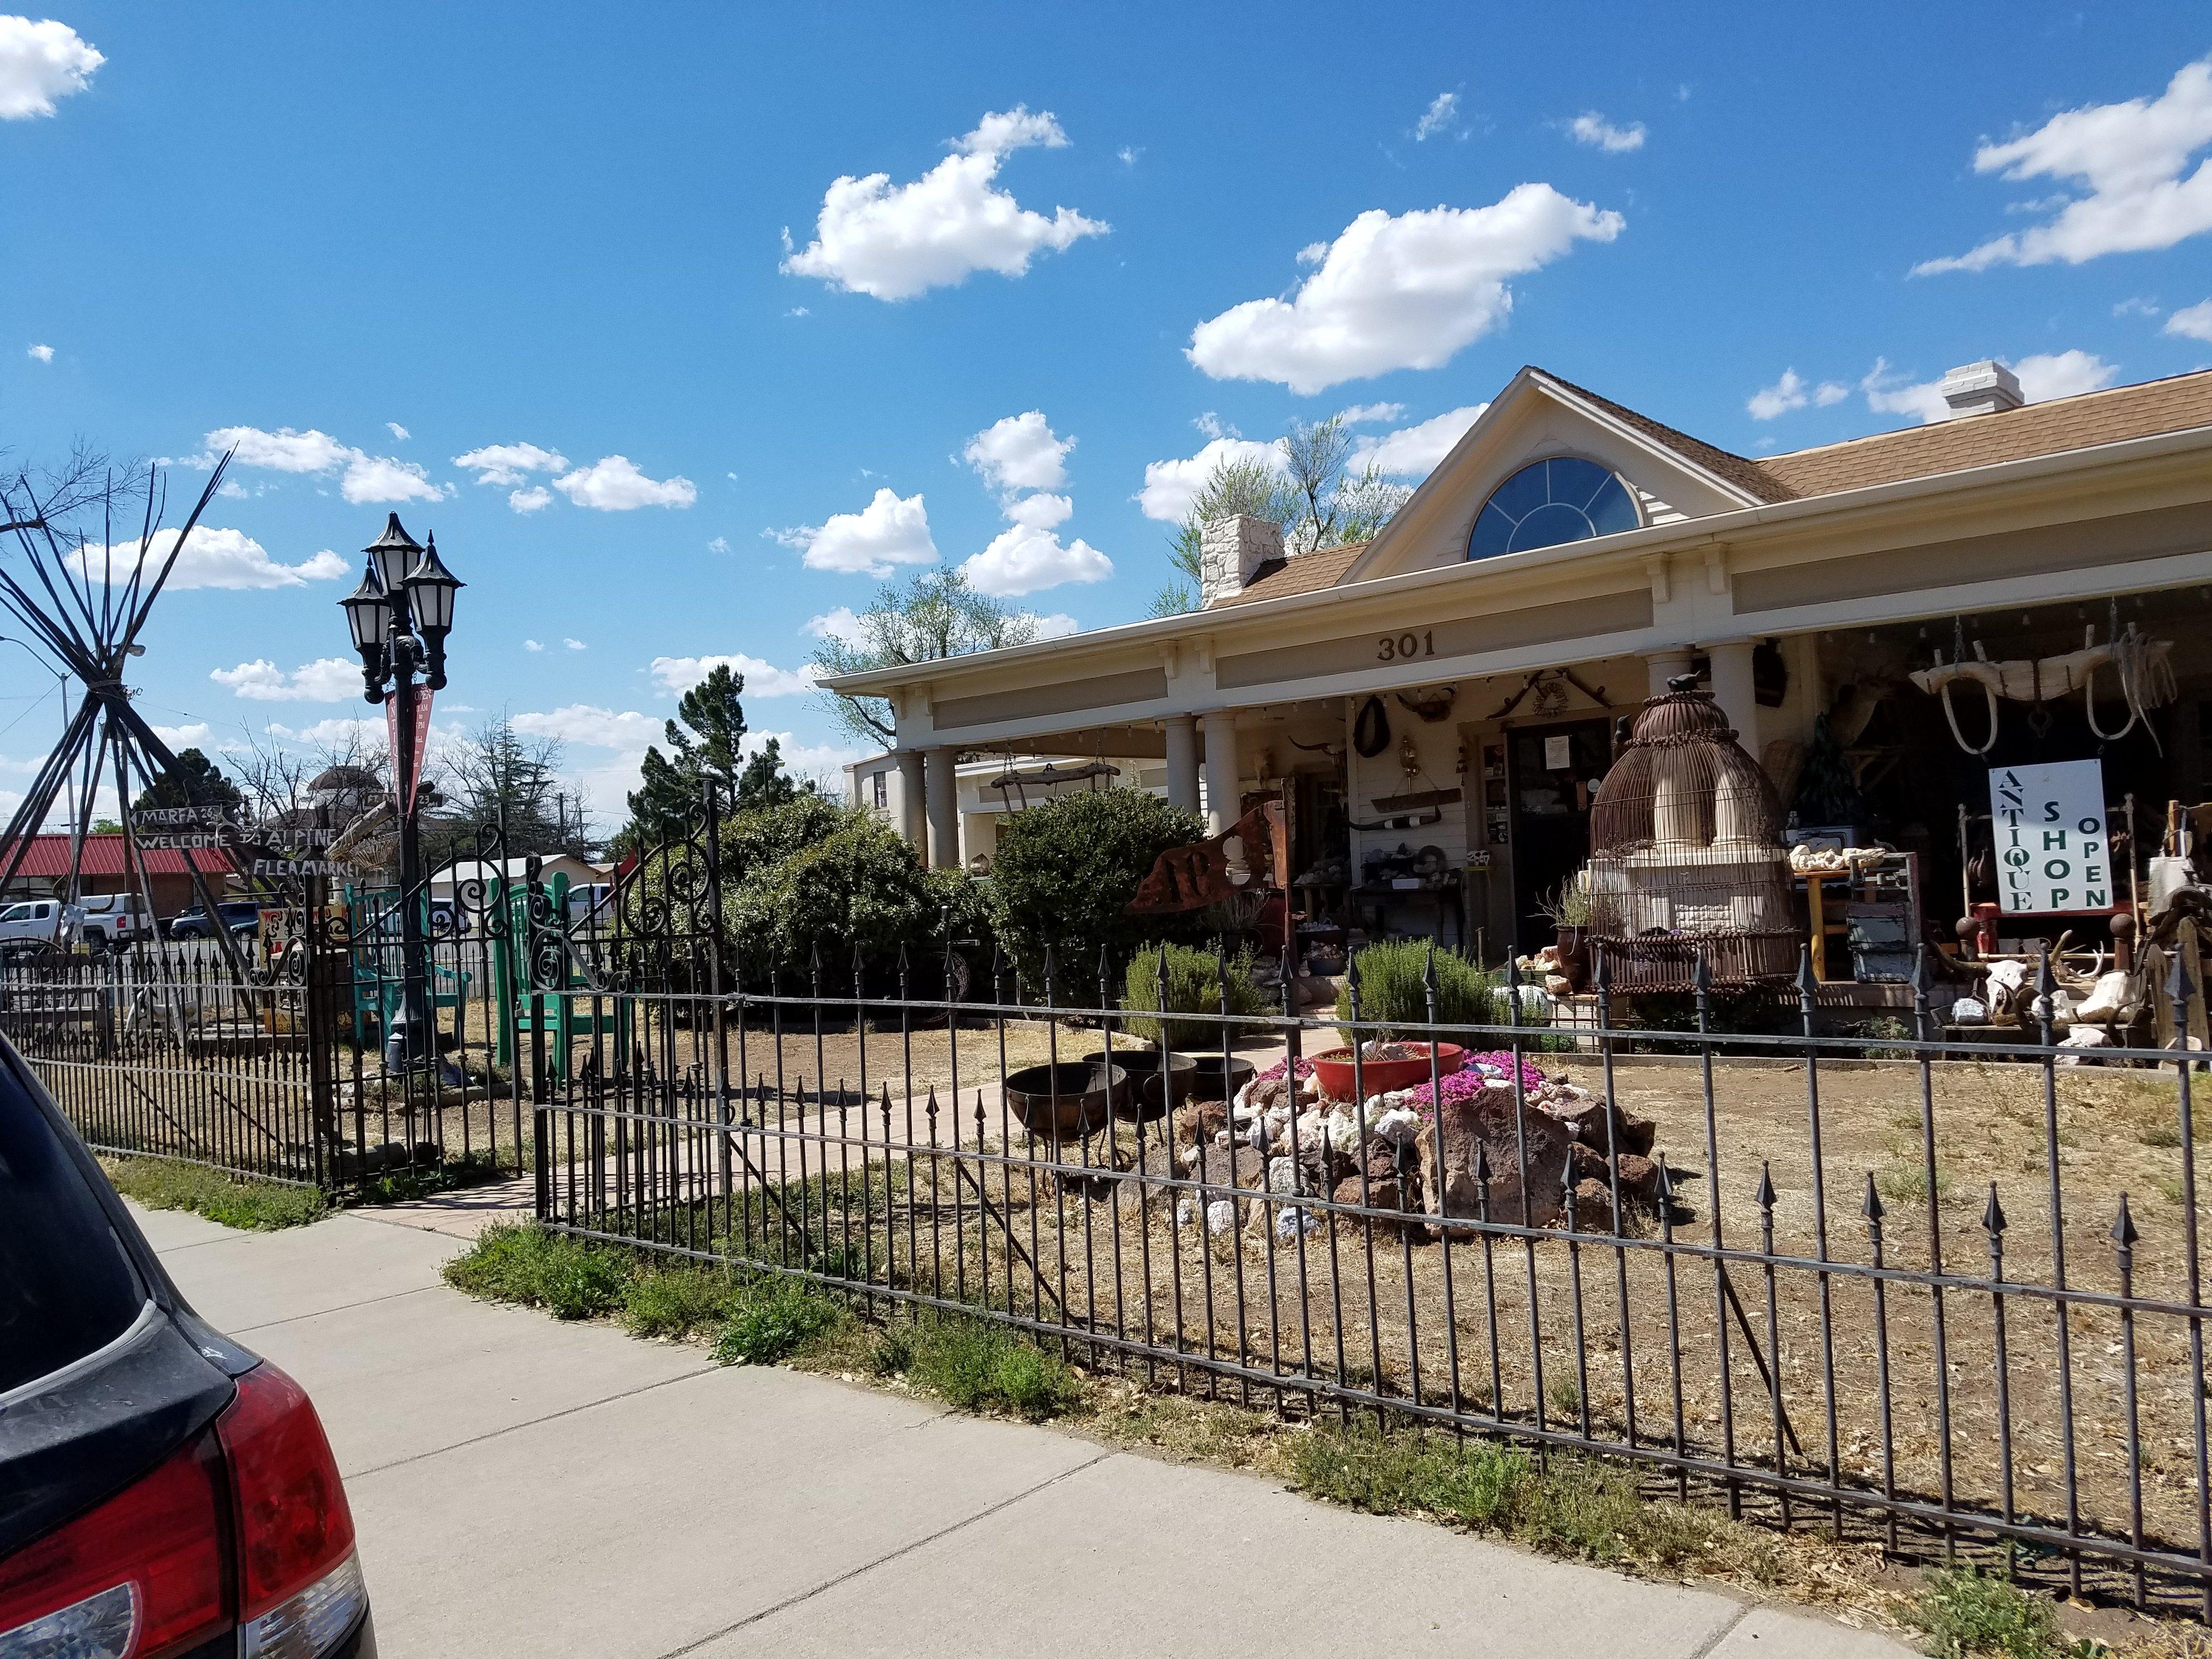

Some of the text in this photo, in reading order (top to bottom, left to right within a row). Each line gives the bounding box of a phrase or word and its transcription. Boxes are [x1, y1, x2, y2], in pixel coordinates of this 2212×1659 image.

[1376, 630, 1435, 661] 301
[414, 690, 432, 701] OPEN
[419, 794, 430, 804] 23
[142, 808, 199, 825] MARFA
[201, 807, 213, 819] 26
[135, 833, 232, 849] WELCOME
[1997, 769, 2033, 911] ANTIQUE
[2042, 801, 2070, 909] SHOP
[2078, 817, 2106, 907] OPEN
[253, 859, 298, 876] FLEA
